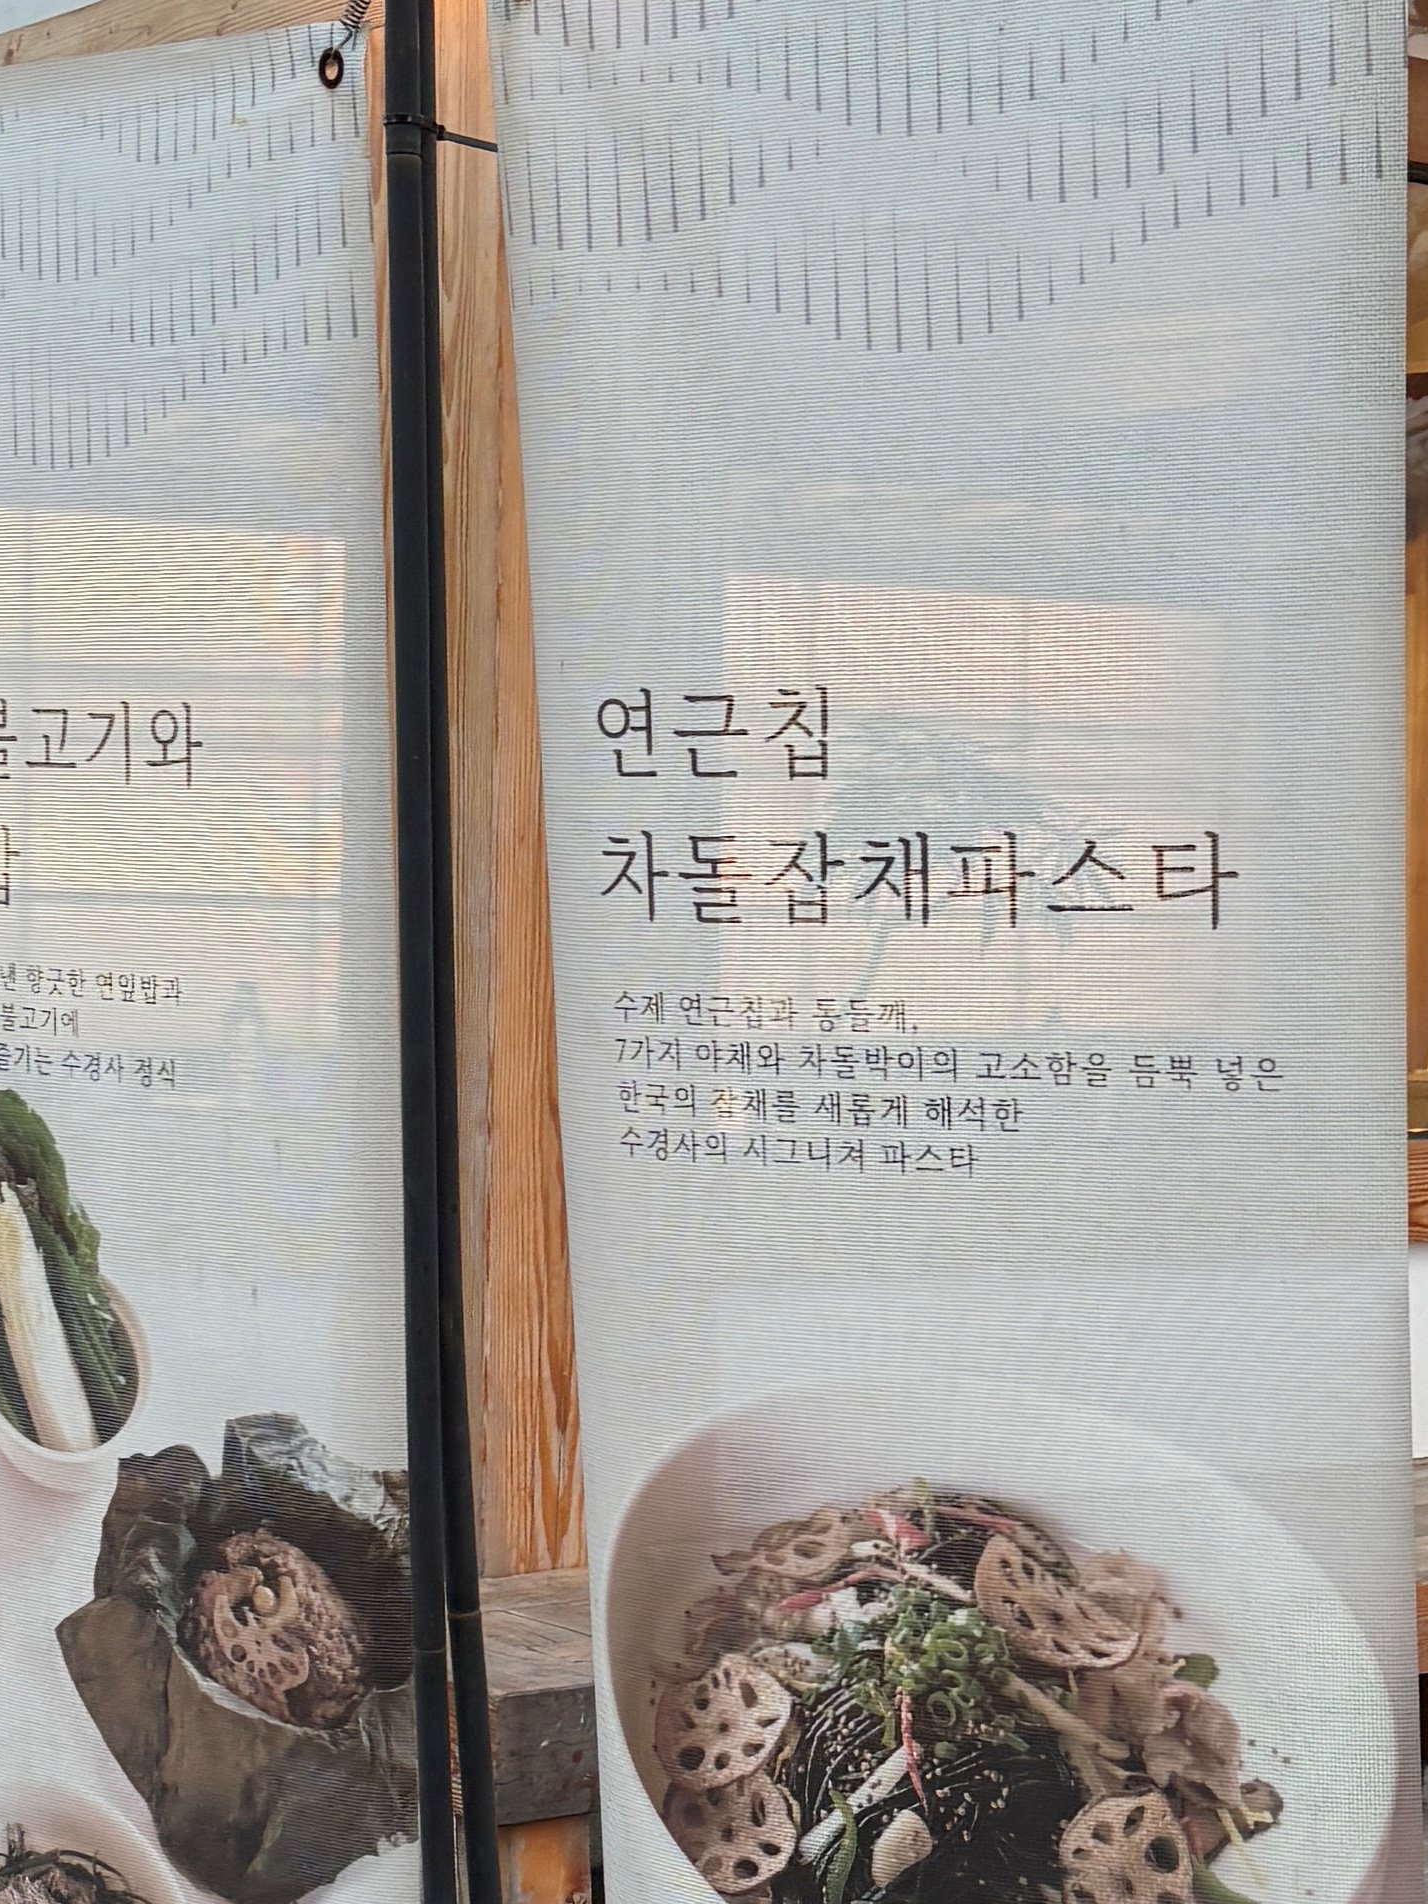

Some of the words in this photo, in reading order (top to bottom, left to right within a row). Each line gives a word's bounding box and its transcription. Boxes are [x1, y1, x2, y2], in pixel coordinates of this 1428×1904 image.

[596, 684, 831, 782] 연근칩
[600, 829, 1240, 930] 차돌잡채파스타
[26, 965, 87, 998] 향긋한
[96, 972, 183, 1006] 연잎밥과
[614, 991, 664, 1024] 수제
[679, 993, 799, 1030] 연근칩과
[0, 1003, 79, 1038] 불고기에
[61, 1050, 125, 1083] 수경사
[134, 1057, 175, 1088] 정식
[615, 1036, 681, 1071] 7가지
[696, 1039, 785, 1077] 야채와
[798, 1043, 958, 1083] 차돌박이의
[976, 1051, 1112, 1087] 고소함을
[1129, 1054, 1198, 1089] 듬뿍
[1216, 1054, 1284, 1092] 넣은
[618, 1080, 696, 1118] 한국의
[711, 1086, 801, 1123] 잡채를
[814, 1091, 908, 1128] 새롭게
[924, 1096, 1023, 1132] 해석한
[620, 1126, 728, 1165] 수경사의
[743, 1134, 864, 1173] 시그니쳐
[879, 1140, 980, 1178] 파스타
